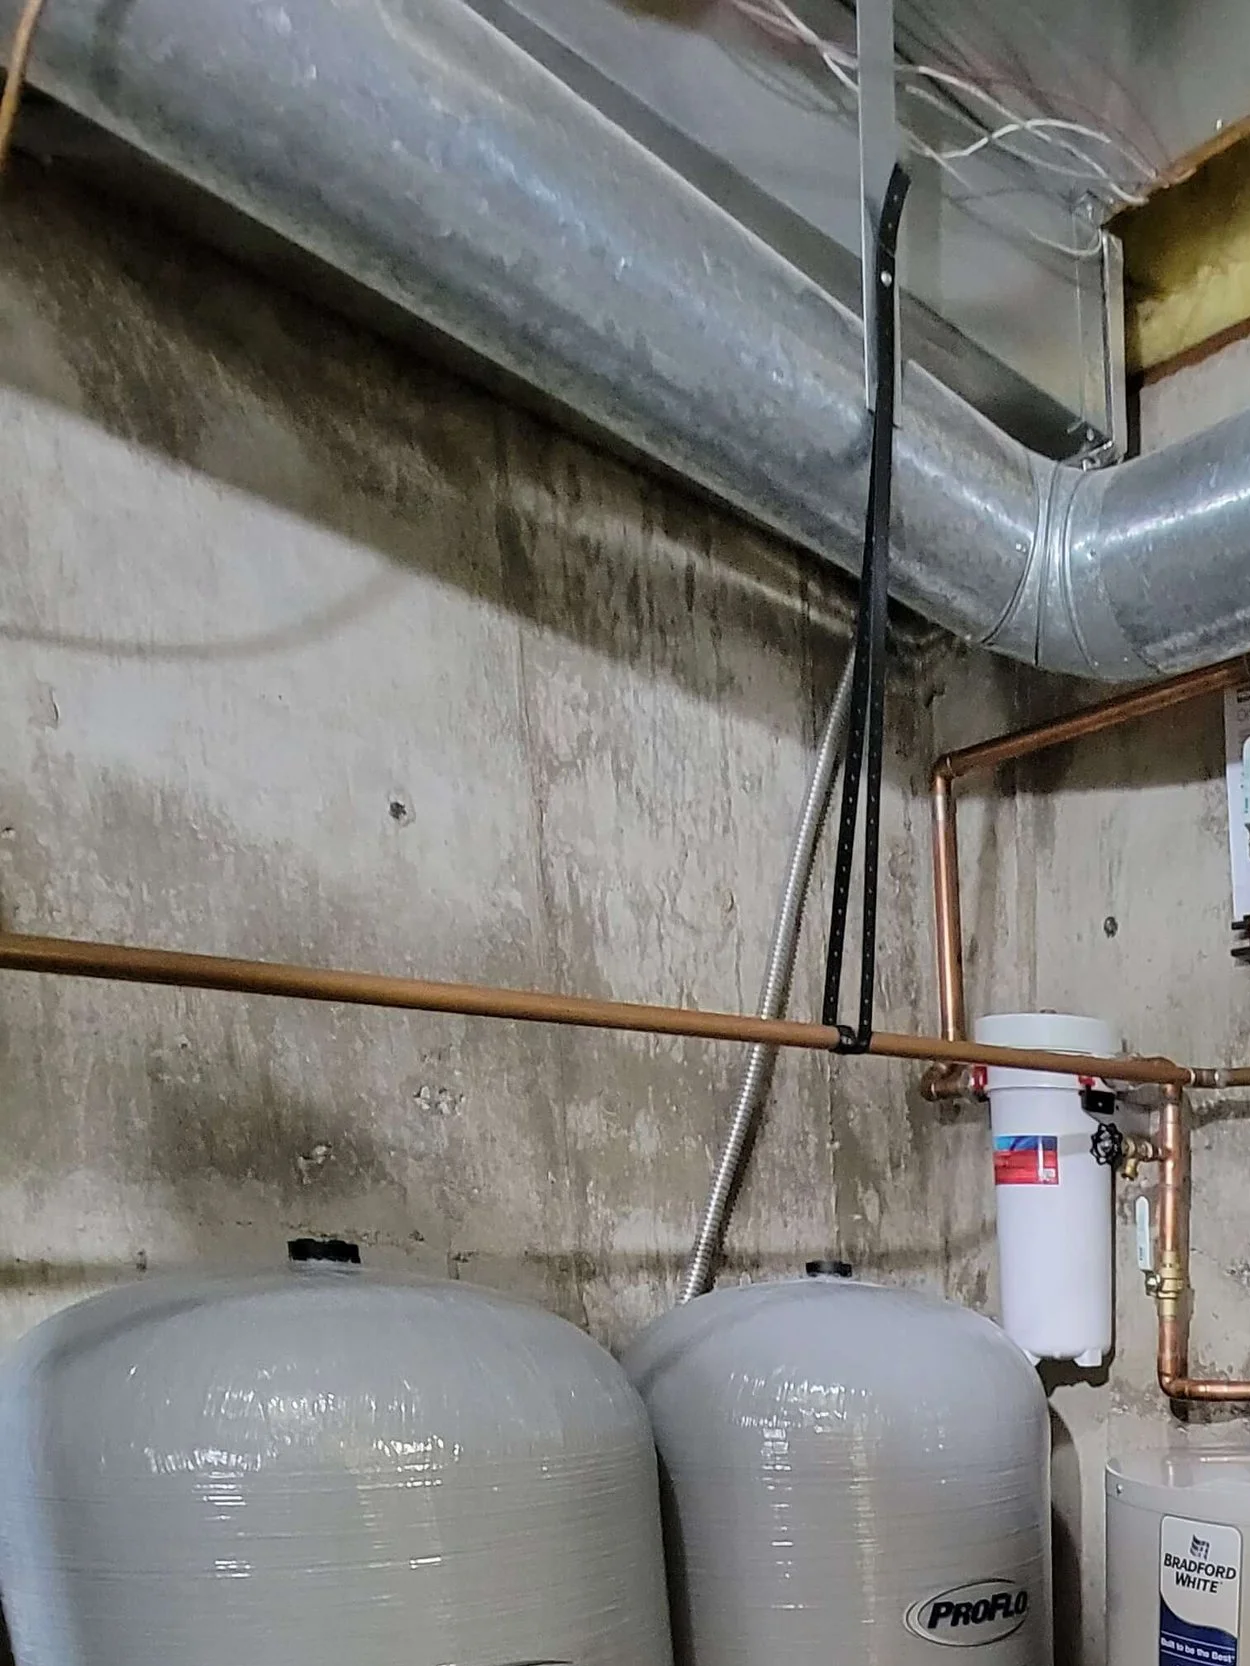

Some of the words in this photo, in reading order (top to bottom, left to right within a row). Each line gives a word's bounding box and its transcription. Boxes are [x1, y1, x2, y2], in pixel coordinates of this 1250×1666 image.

[1164, 1553, 1237, 1580] BRADFORD
[1175, 1571, 1219, 1593] WHITE
[926, 1590, 1028, 1629] PROFLO
